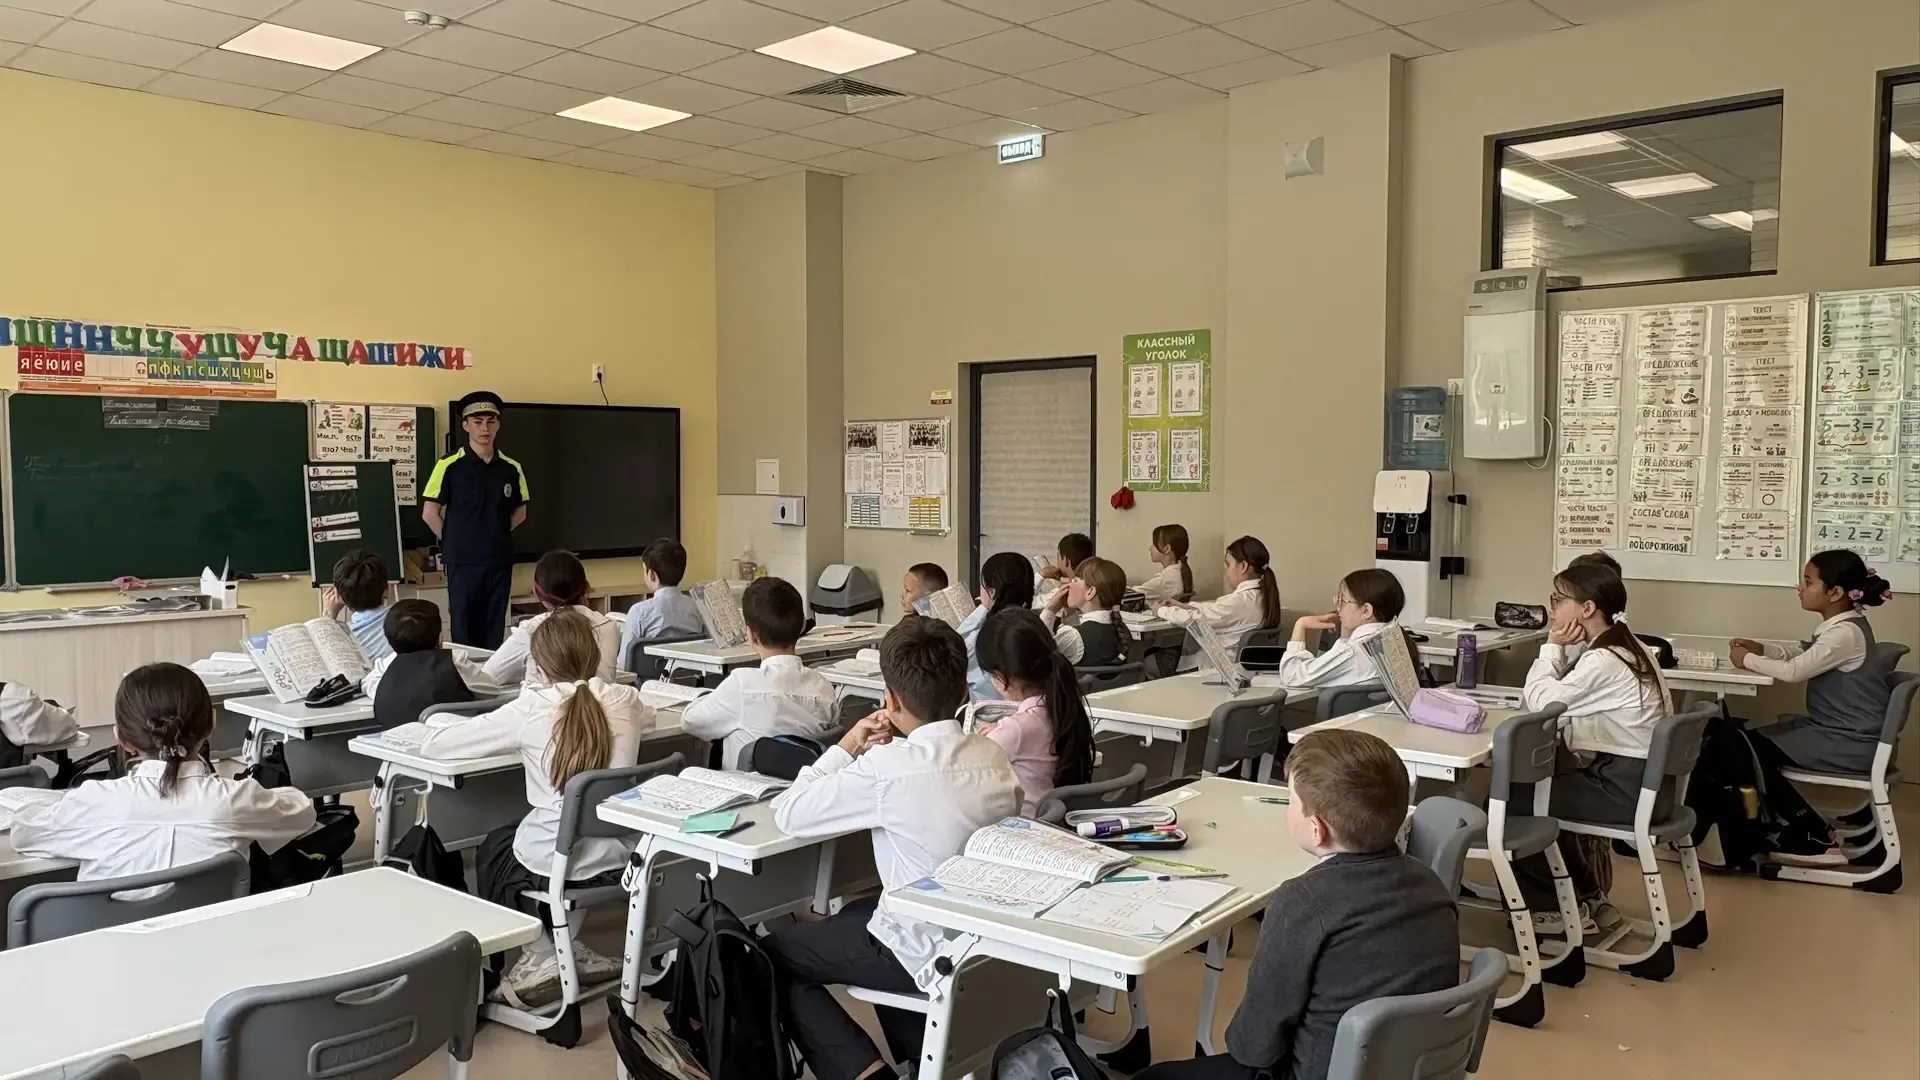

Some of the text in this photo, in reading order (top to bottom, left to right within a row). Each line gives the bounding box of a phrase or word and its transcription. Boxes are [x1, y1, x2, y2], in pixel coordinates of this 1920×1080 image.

[1137, 333, 1195, 349] КЛАССНЫЙ
[1145, 349, 1187, 361] УГОЛОК
[1826, 366, 1834, 379] 2
[1856, 365, 1864, 379] 3
[1883, 363, 1893, 377] 5
[1851, 418, 1861, 433] 3
[1876, 418, 1885, 433] 2
[1820, 472, 1829, 486] 2
[1850, 472, 1859, 486] 3
[1877, 472, 1886, 486] 6
[1633, 508, 1662, 519] СОСТАВ
[1818, 525, 1828, 539] 4
[1847, 526, 1856, 541] 2
[1875, 528, 1884, 542] 2
